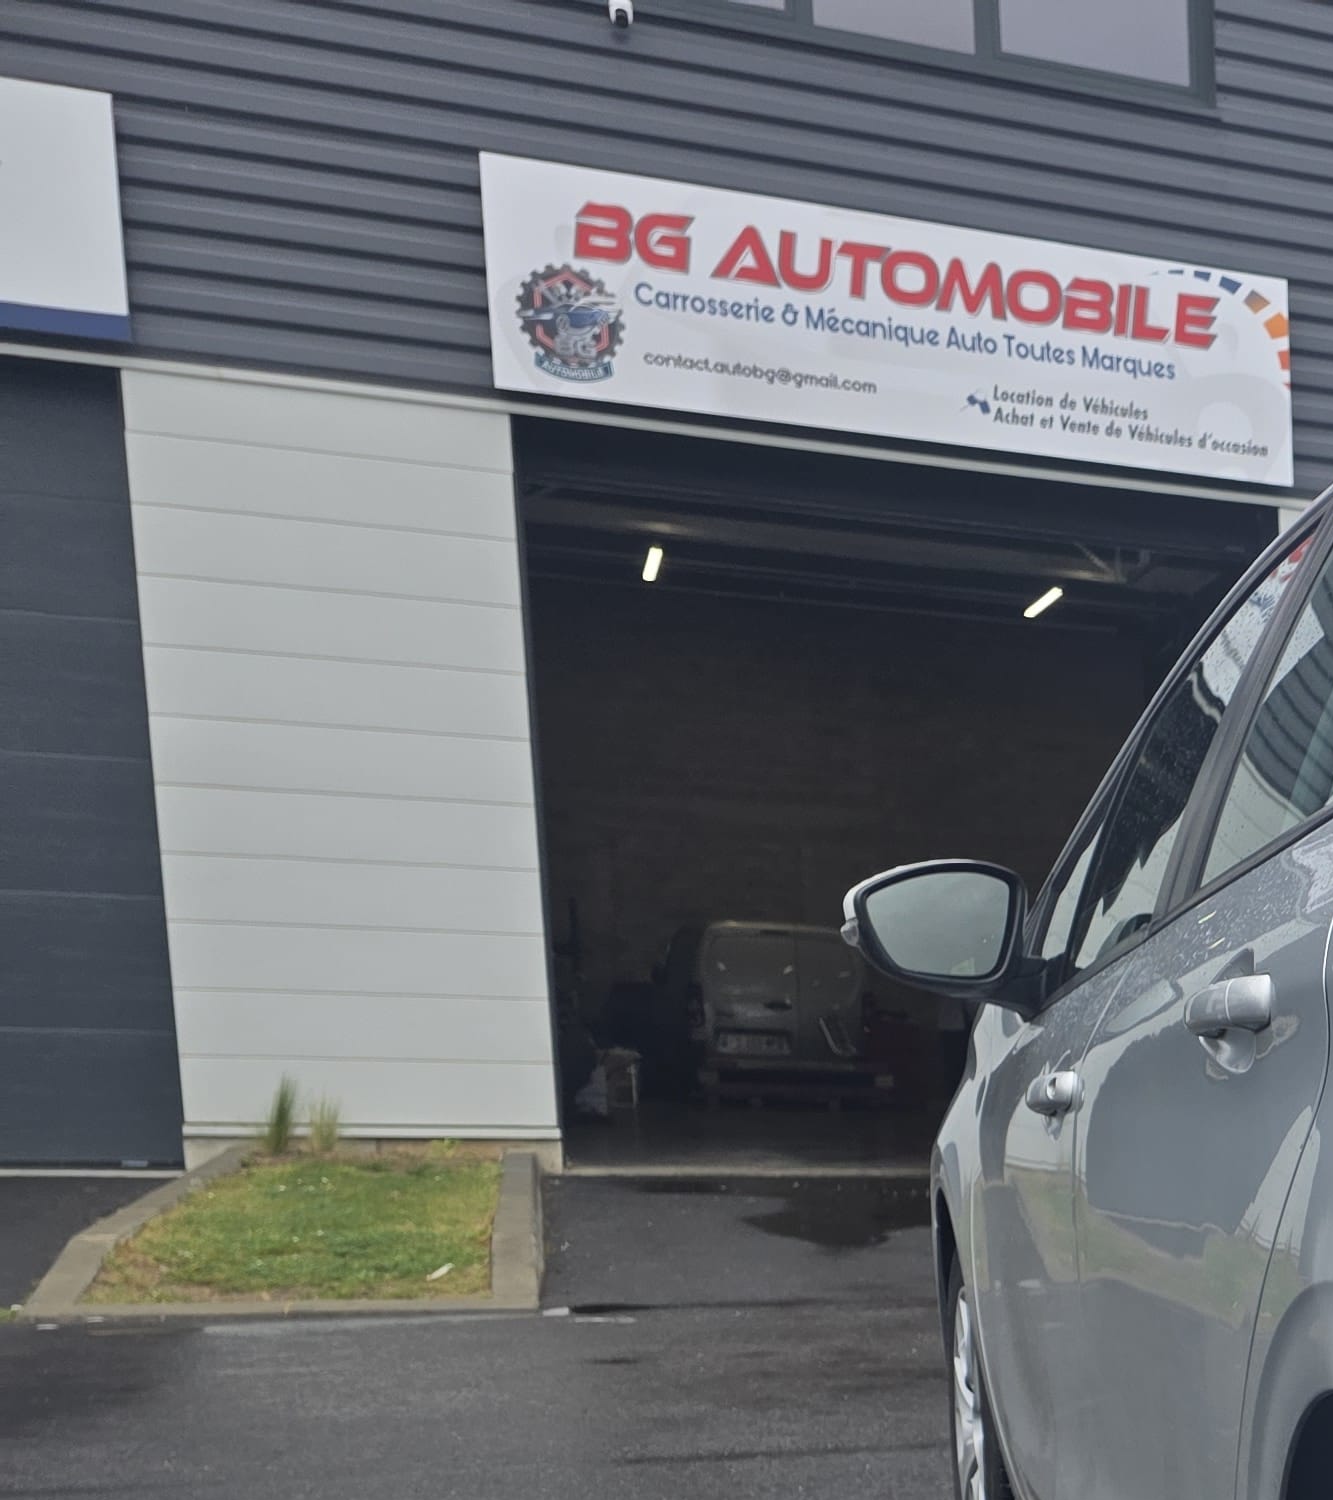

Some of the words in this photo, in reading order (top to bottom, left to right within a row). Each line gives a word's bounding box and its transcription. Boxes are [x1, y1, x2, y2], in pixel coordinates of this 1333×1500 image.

[574, 201, 696, 275] BG
[709, 224, 1221, 351] AUTOMOBILE
[634, 282, 776, 324] Carrosserie
[781, 302, 799, 327] &
[804, 304, 940, 345] Mécanique
[946, 326, 998, 355] Auto
[1002, 334, 1076, 367] Toutes
[1081, 345, 1176, 380] Marques
[643, 351, 878, 395] contact.autobg@gmail.com
[992, 384, 1054, 409] Location
[1059, 392, 1077, 412] de
[1083, 396, 1149, 421] Véhicules
[993, 407, 1035, 428] Achat
[1039, 412, 1053, 430] et
[1060, 416, 1100, 436] Vente
[1105, 423, 1123, 440] de
[1128, 424, 1193, 448] Véhicules
[1197, 432, 1269, 458] d'occasion
